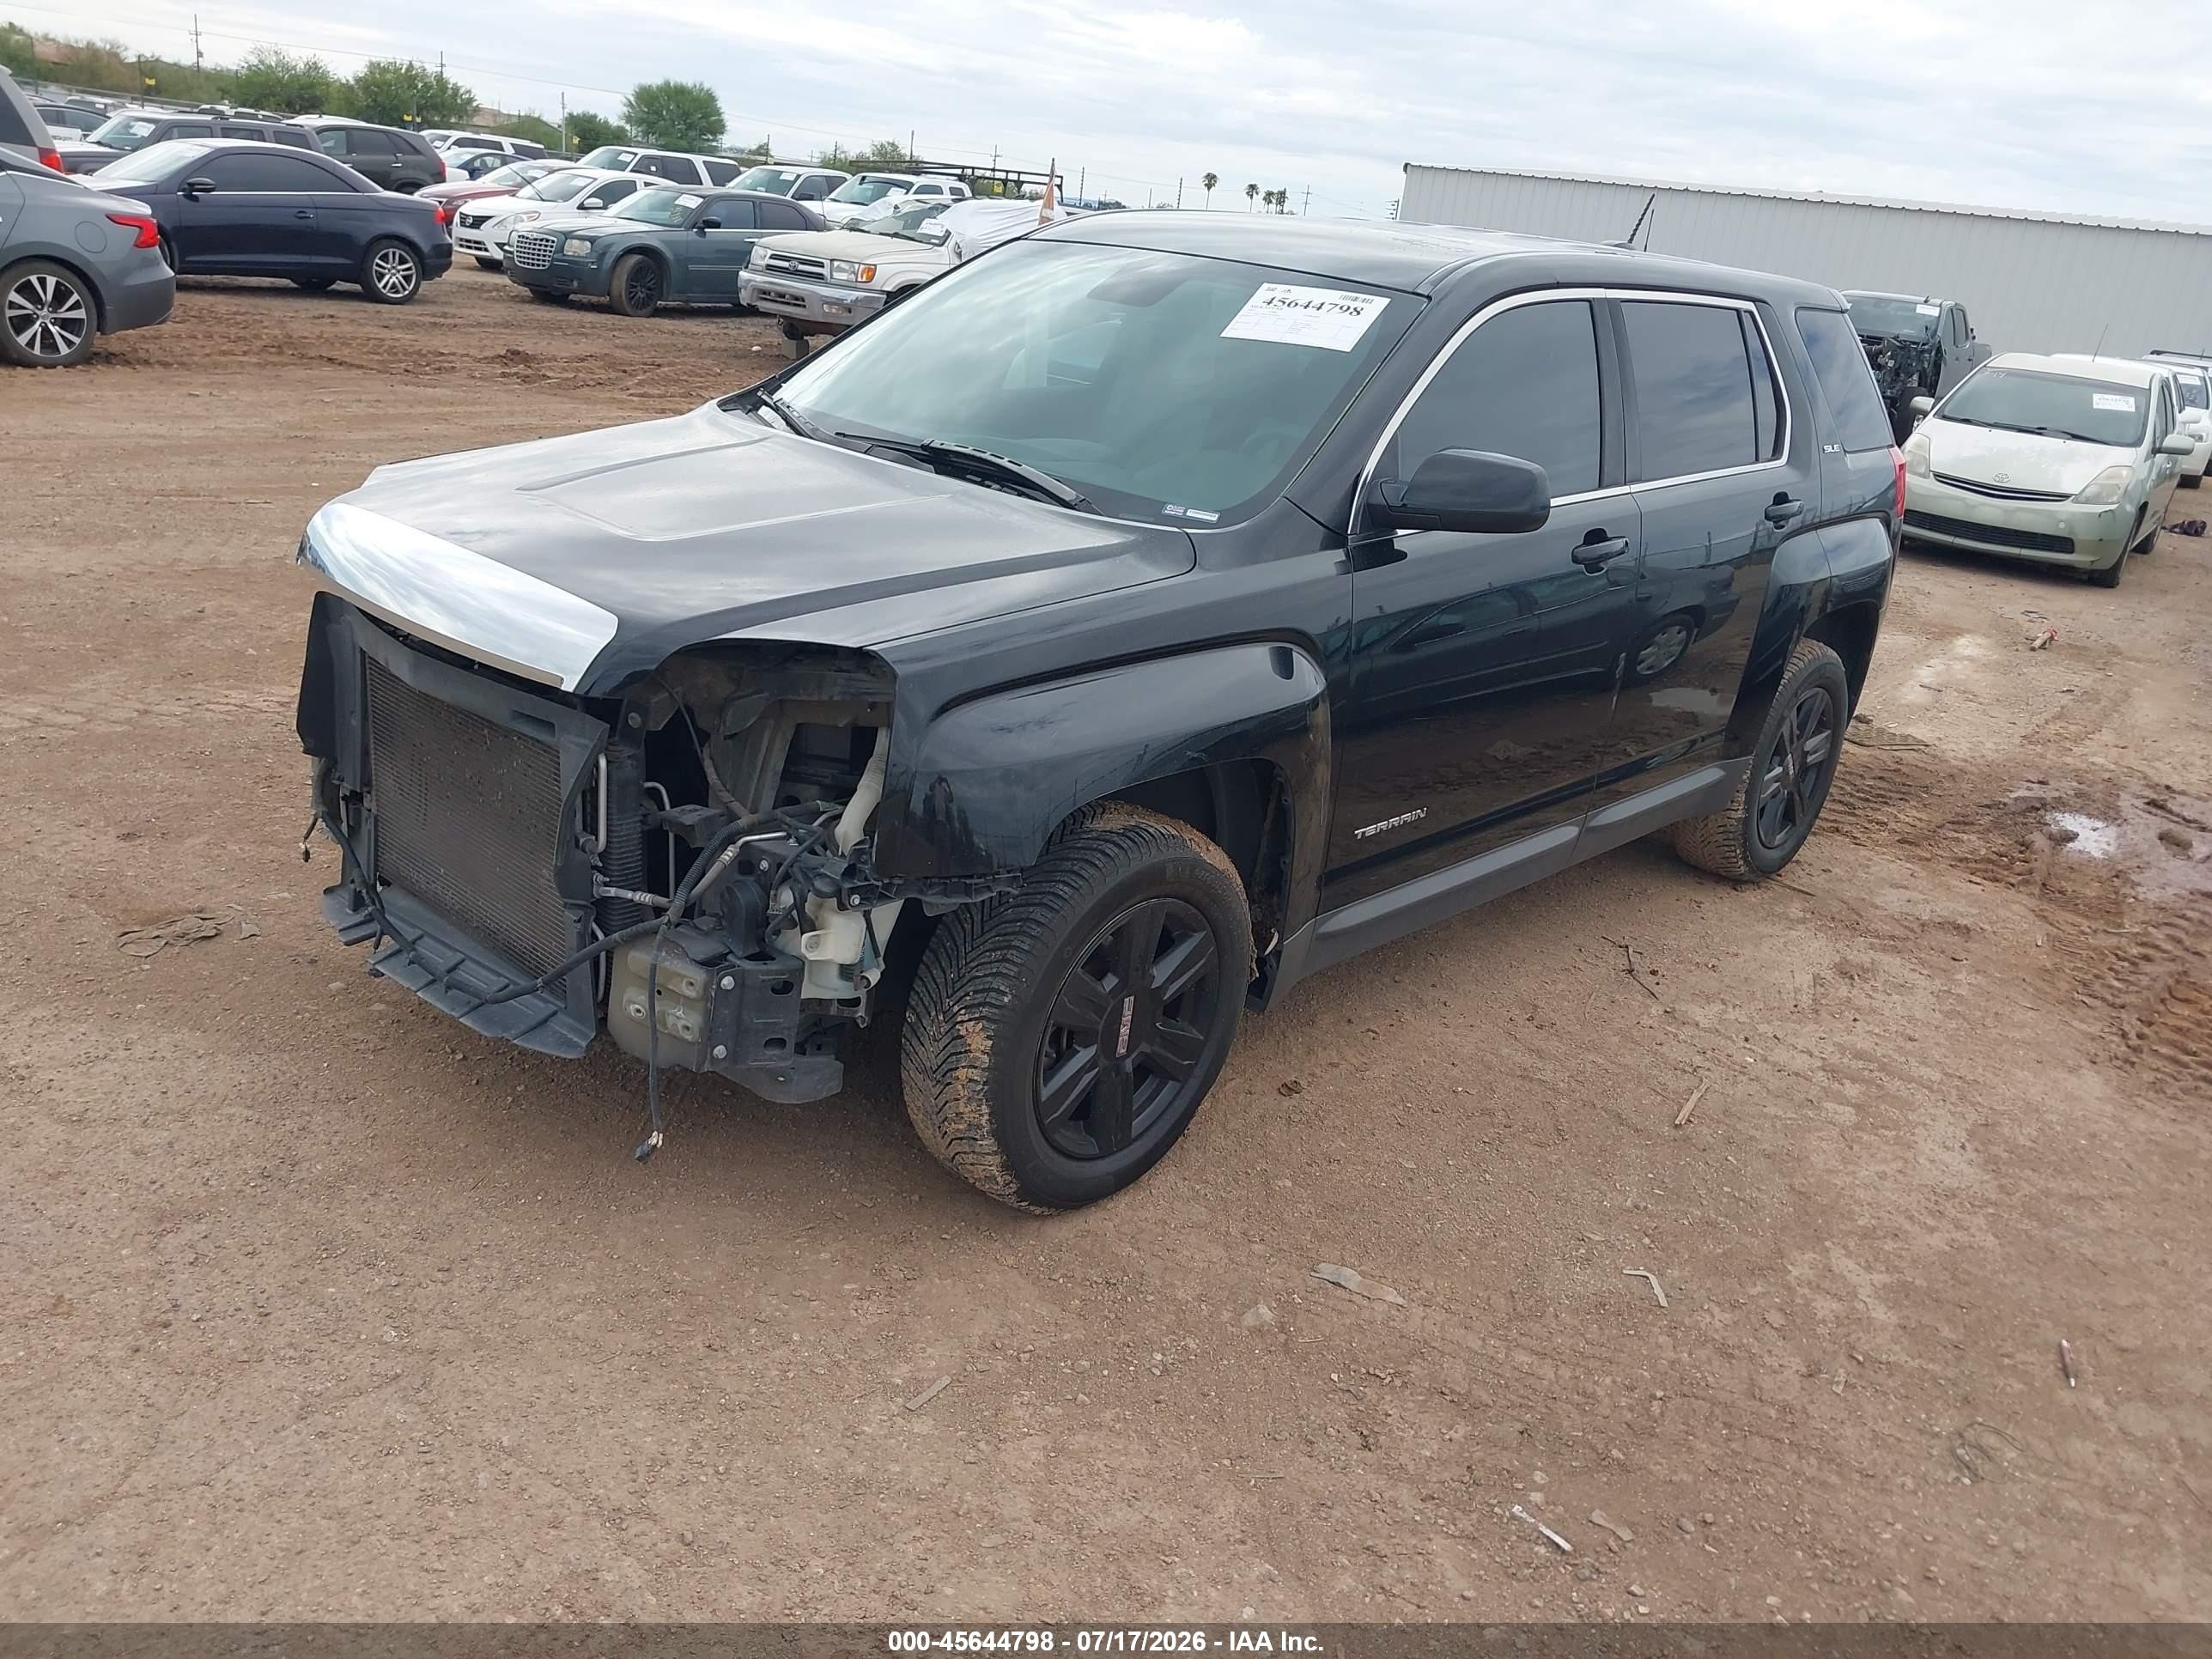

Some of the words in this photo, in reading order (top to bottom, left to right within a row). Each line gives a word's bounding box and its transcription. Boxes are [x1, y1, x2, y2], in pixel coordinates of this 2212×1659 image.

[1262, 295, 1364, 317] 45644798
[1823, 444, 1841, 453] SLE
[1354, 807, 1427, 840] TERRAIN
[1117, 996, 1134, 1056] GMC
